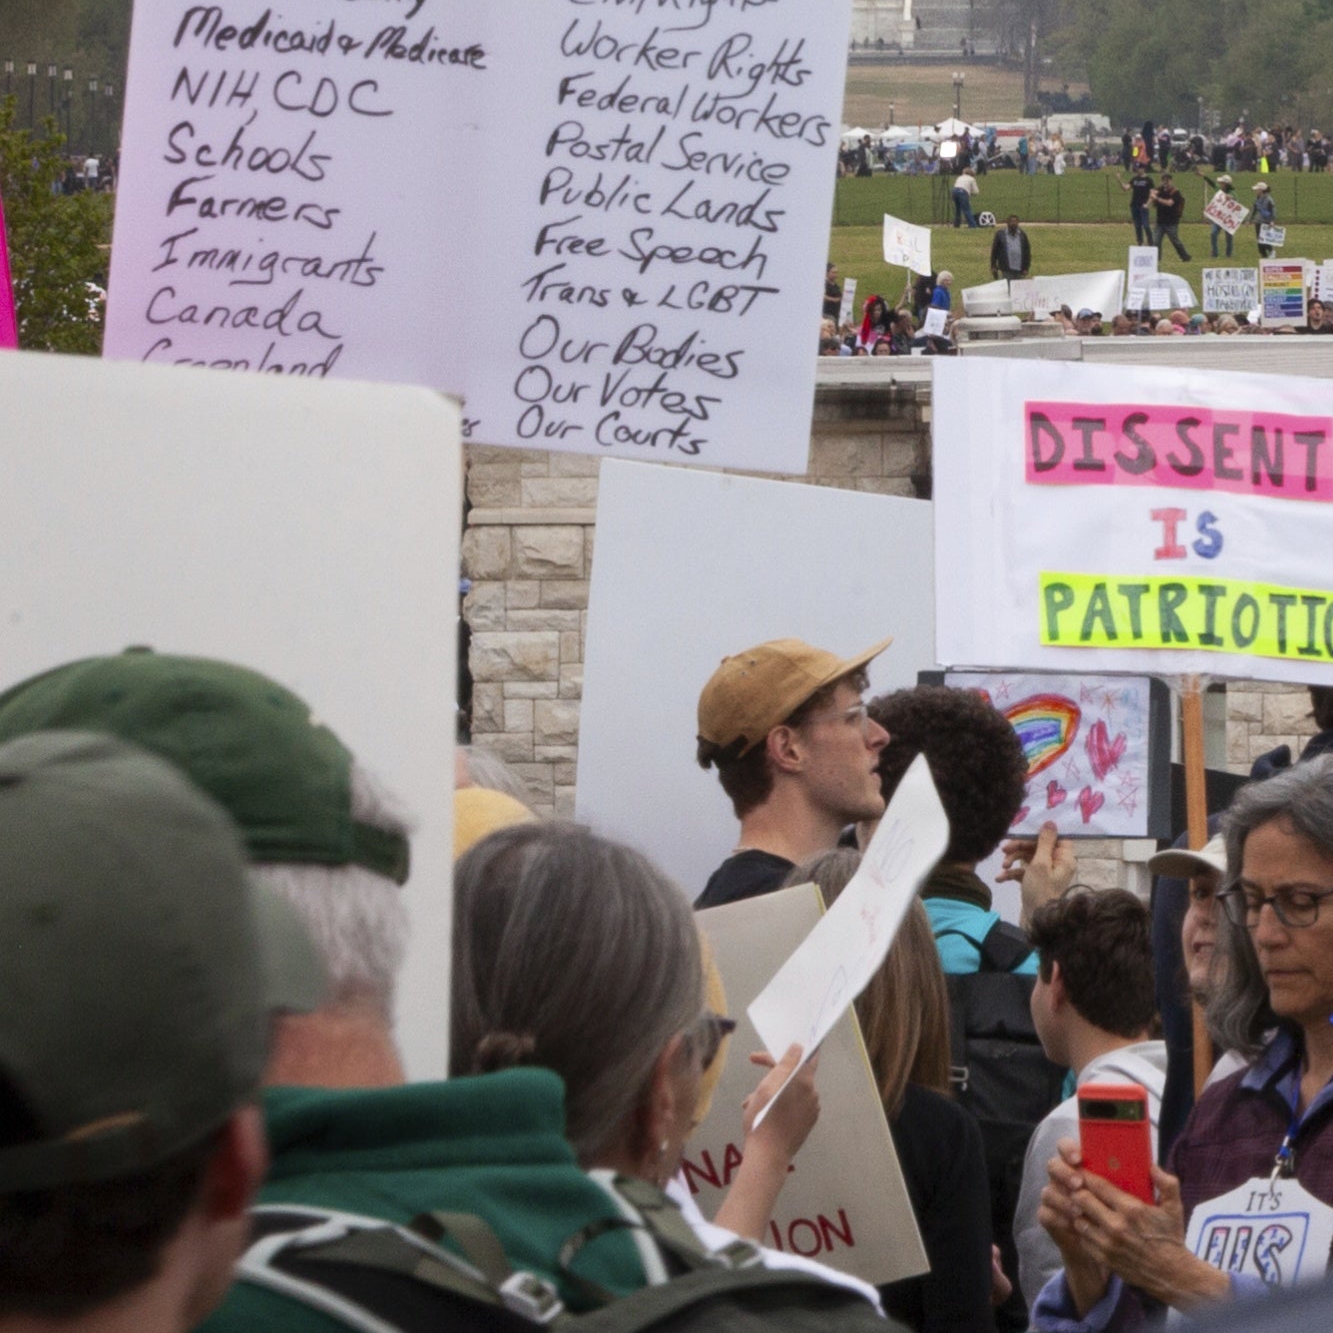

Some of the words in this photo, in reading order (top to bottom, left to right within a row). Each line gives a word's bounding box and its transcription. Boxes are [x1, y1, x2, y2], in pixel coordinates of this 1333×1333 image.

[173, 6, 335, 56] Medicaid
[363, 25, 488, 70] Medicare
[560, 18, 702, 71] Worker
[707, 32, 813, 103] Rights
[273, 70, 394, 118] CDC
[558, 71, 690, 120] Federal
[691, 90, 832, 147] Workers
[163, 121, 333, 182] Schools
[546, 120, 665, 164] Postal
[660, 132, 791, 186] Service
[166, 174, 341, 229] Farmers
[540, 165, 652, 213] Public
[660, 179, 786, 234] Lands
[151, 227, 385, 287] Immigrants
[534, 215, 611, 258] Free
[618, 227, 769, 281] Speech
[145, 286, 343, 340] Canada
[520, 262, 611, 309] Trans
[622, 287, 647, 308] &
[656, 280, 781, 317] LGBT
[519, 314, 610, 364] Our
[612, 322, 745, 380] Bodies
[513, 364, 592, 404] Our
[600, 367, 723, 421] Votes
[516, 404, 585, 439] Our
[595, 410, 708, 457] Courts
[1027, 410, 1327, 493] DISSENT
[1150, 507, 1225, 561] IS
[1245, 1190, 1283, 1212] IT'S
